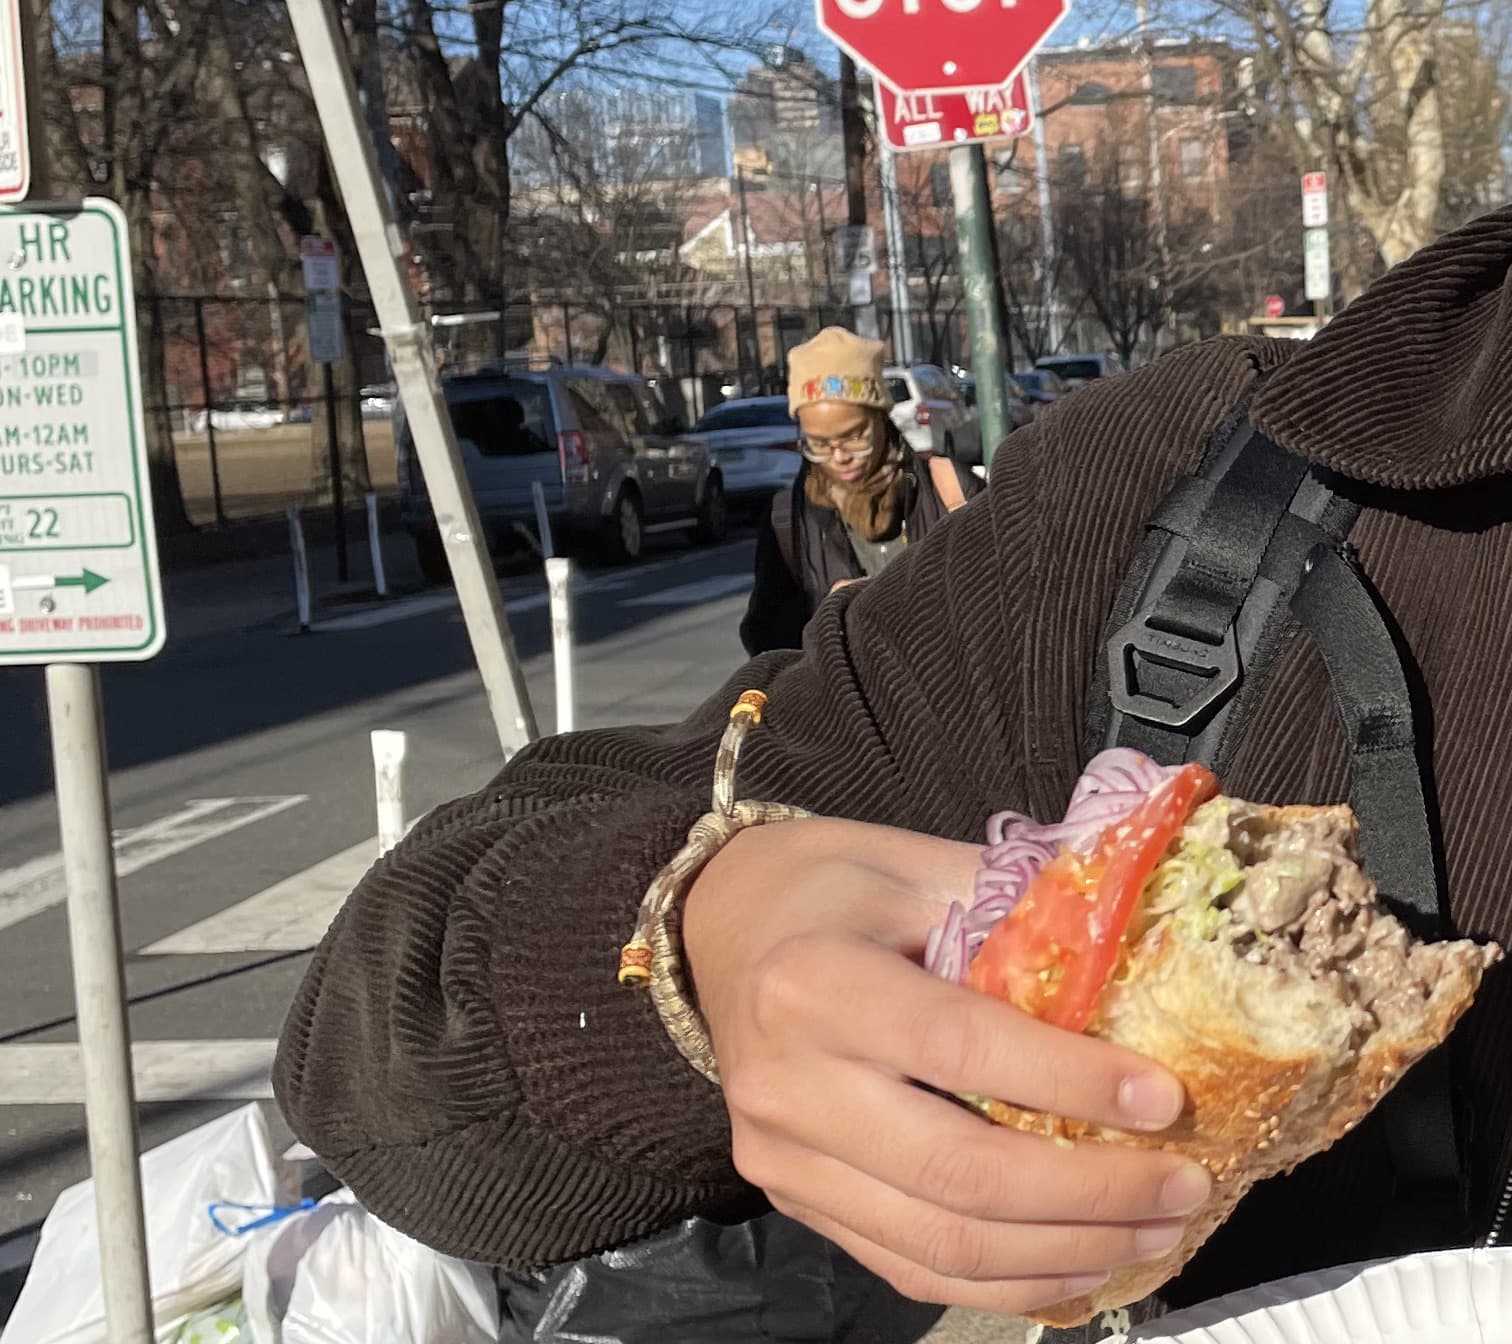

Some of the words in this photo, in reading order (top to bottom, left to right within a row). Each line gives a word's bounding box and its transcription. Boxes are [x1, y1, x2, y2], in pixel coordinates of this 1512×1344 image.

[894, 92, 943, 124] ALL
[966, 87, 1014, 115] WAY
[19, 222, 71, 262] HR
[0, 422, 88, 446] M-12AM
[26, 506, 60, 538] 22
